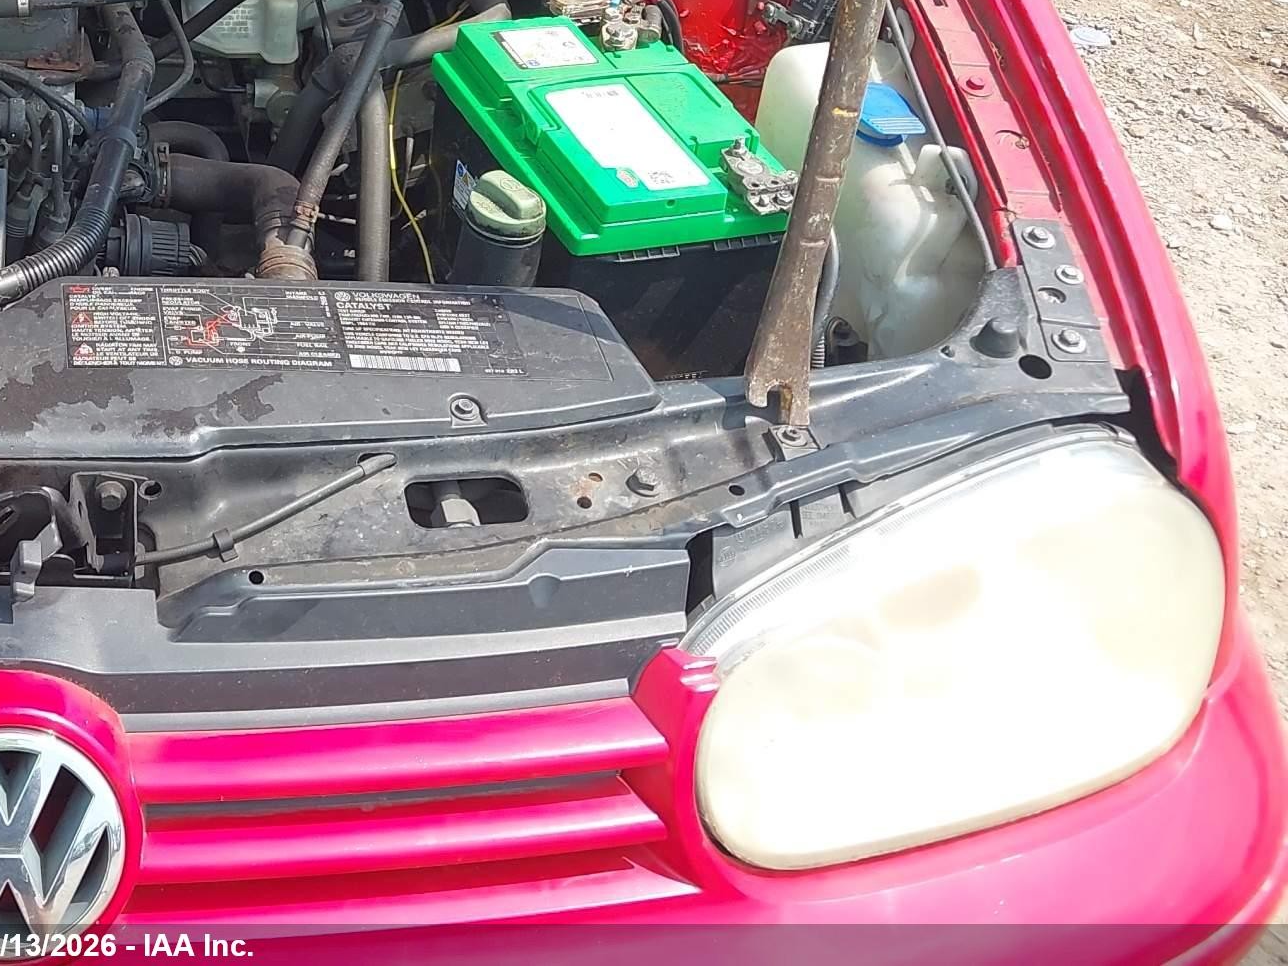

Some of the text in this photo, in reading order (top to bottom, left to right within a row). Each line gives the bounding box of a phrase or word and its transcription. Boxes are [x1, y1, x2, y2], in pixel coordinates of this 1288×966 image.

[352, 291, 420, 300] VOLKSWAGEN
[336, 302, 392, 311] CATALYST
[292, 359, 333, 367] DIAGRAM
